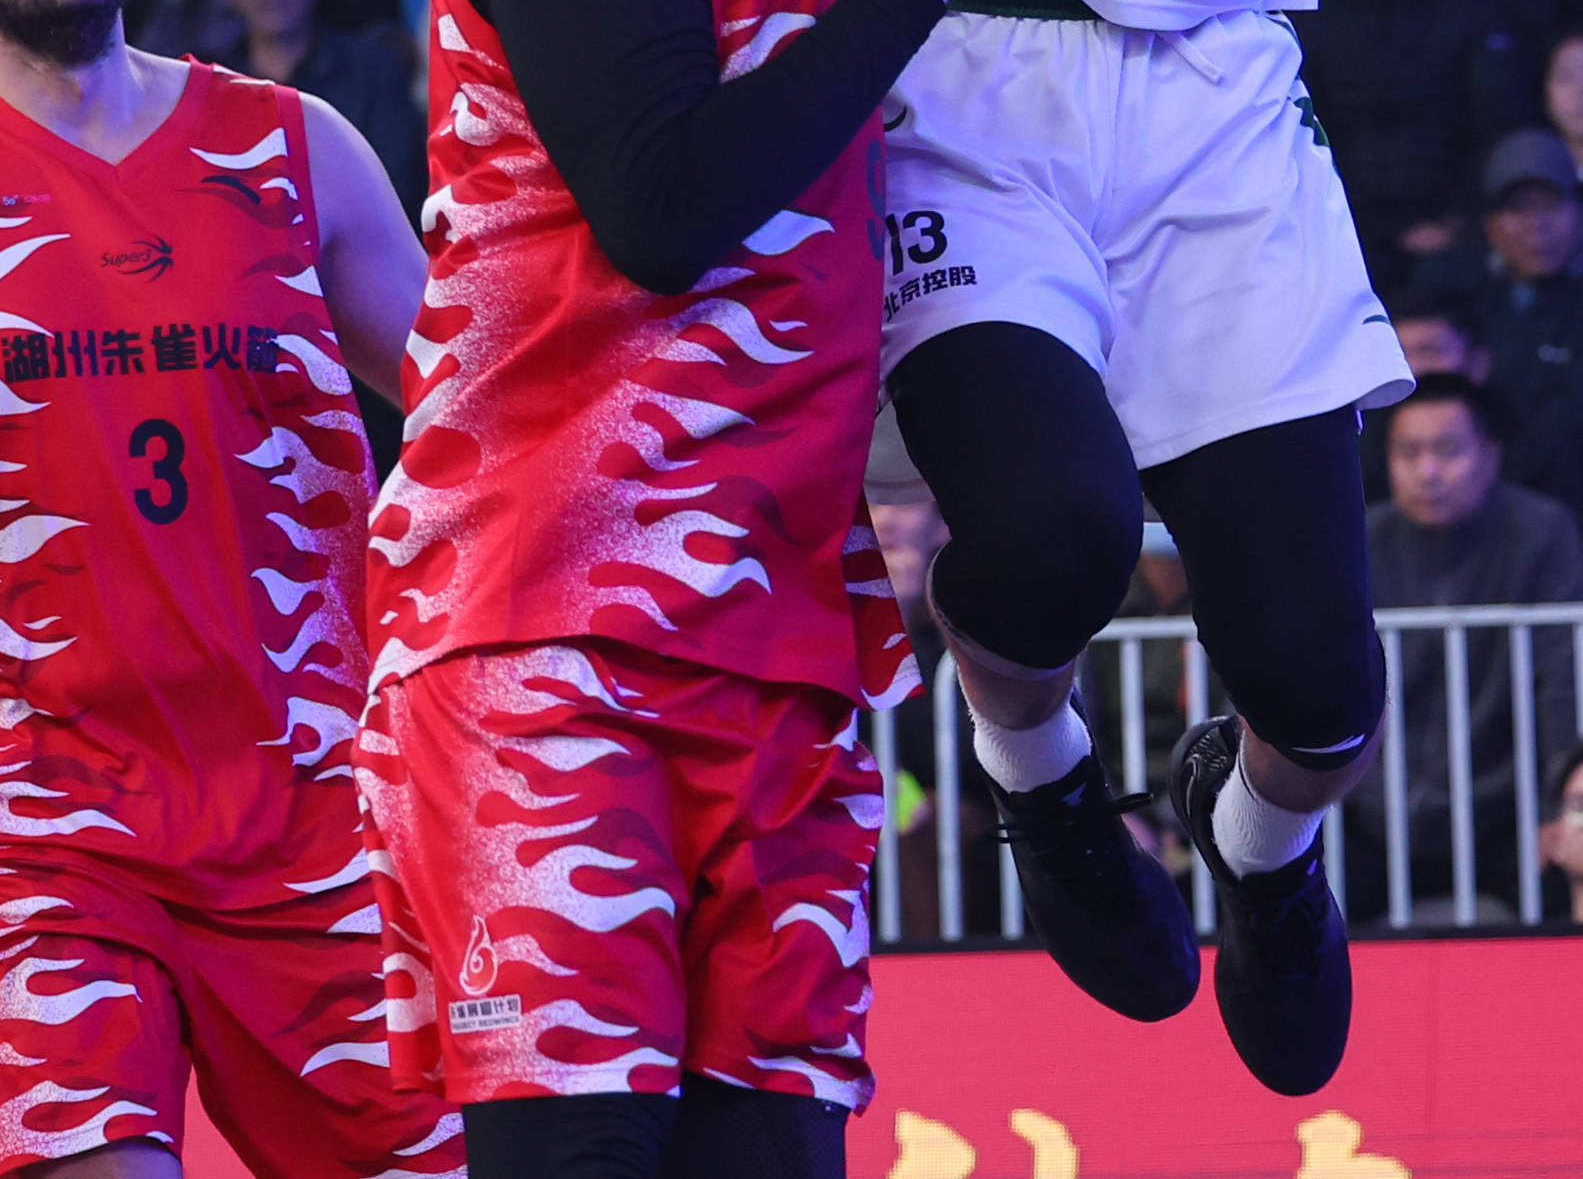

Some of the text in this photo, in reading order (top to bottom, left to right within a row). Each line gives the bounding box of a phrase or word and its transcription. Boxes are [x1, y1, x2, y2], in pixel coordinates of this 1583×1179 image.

[885, 210, 948, 276] 13
[884, 265, 978, 322] 北京控股
[129, 419, 188, 526] 3
